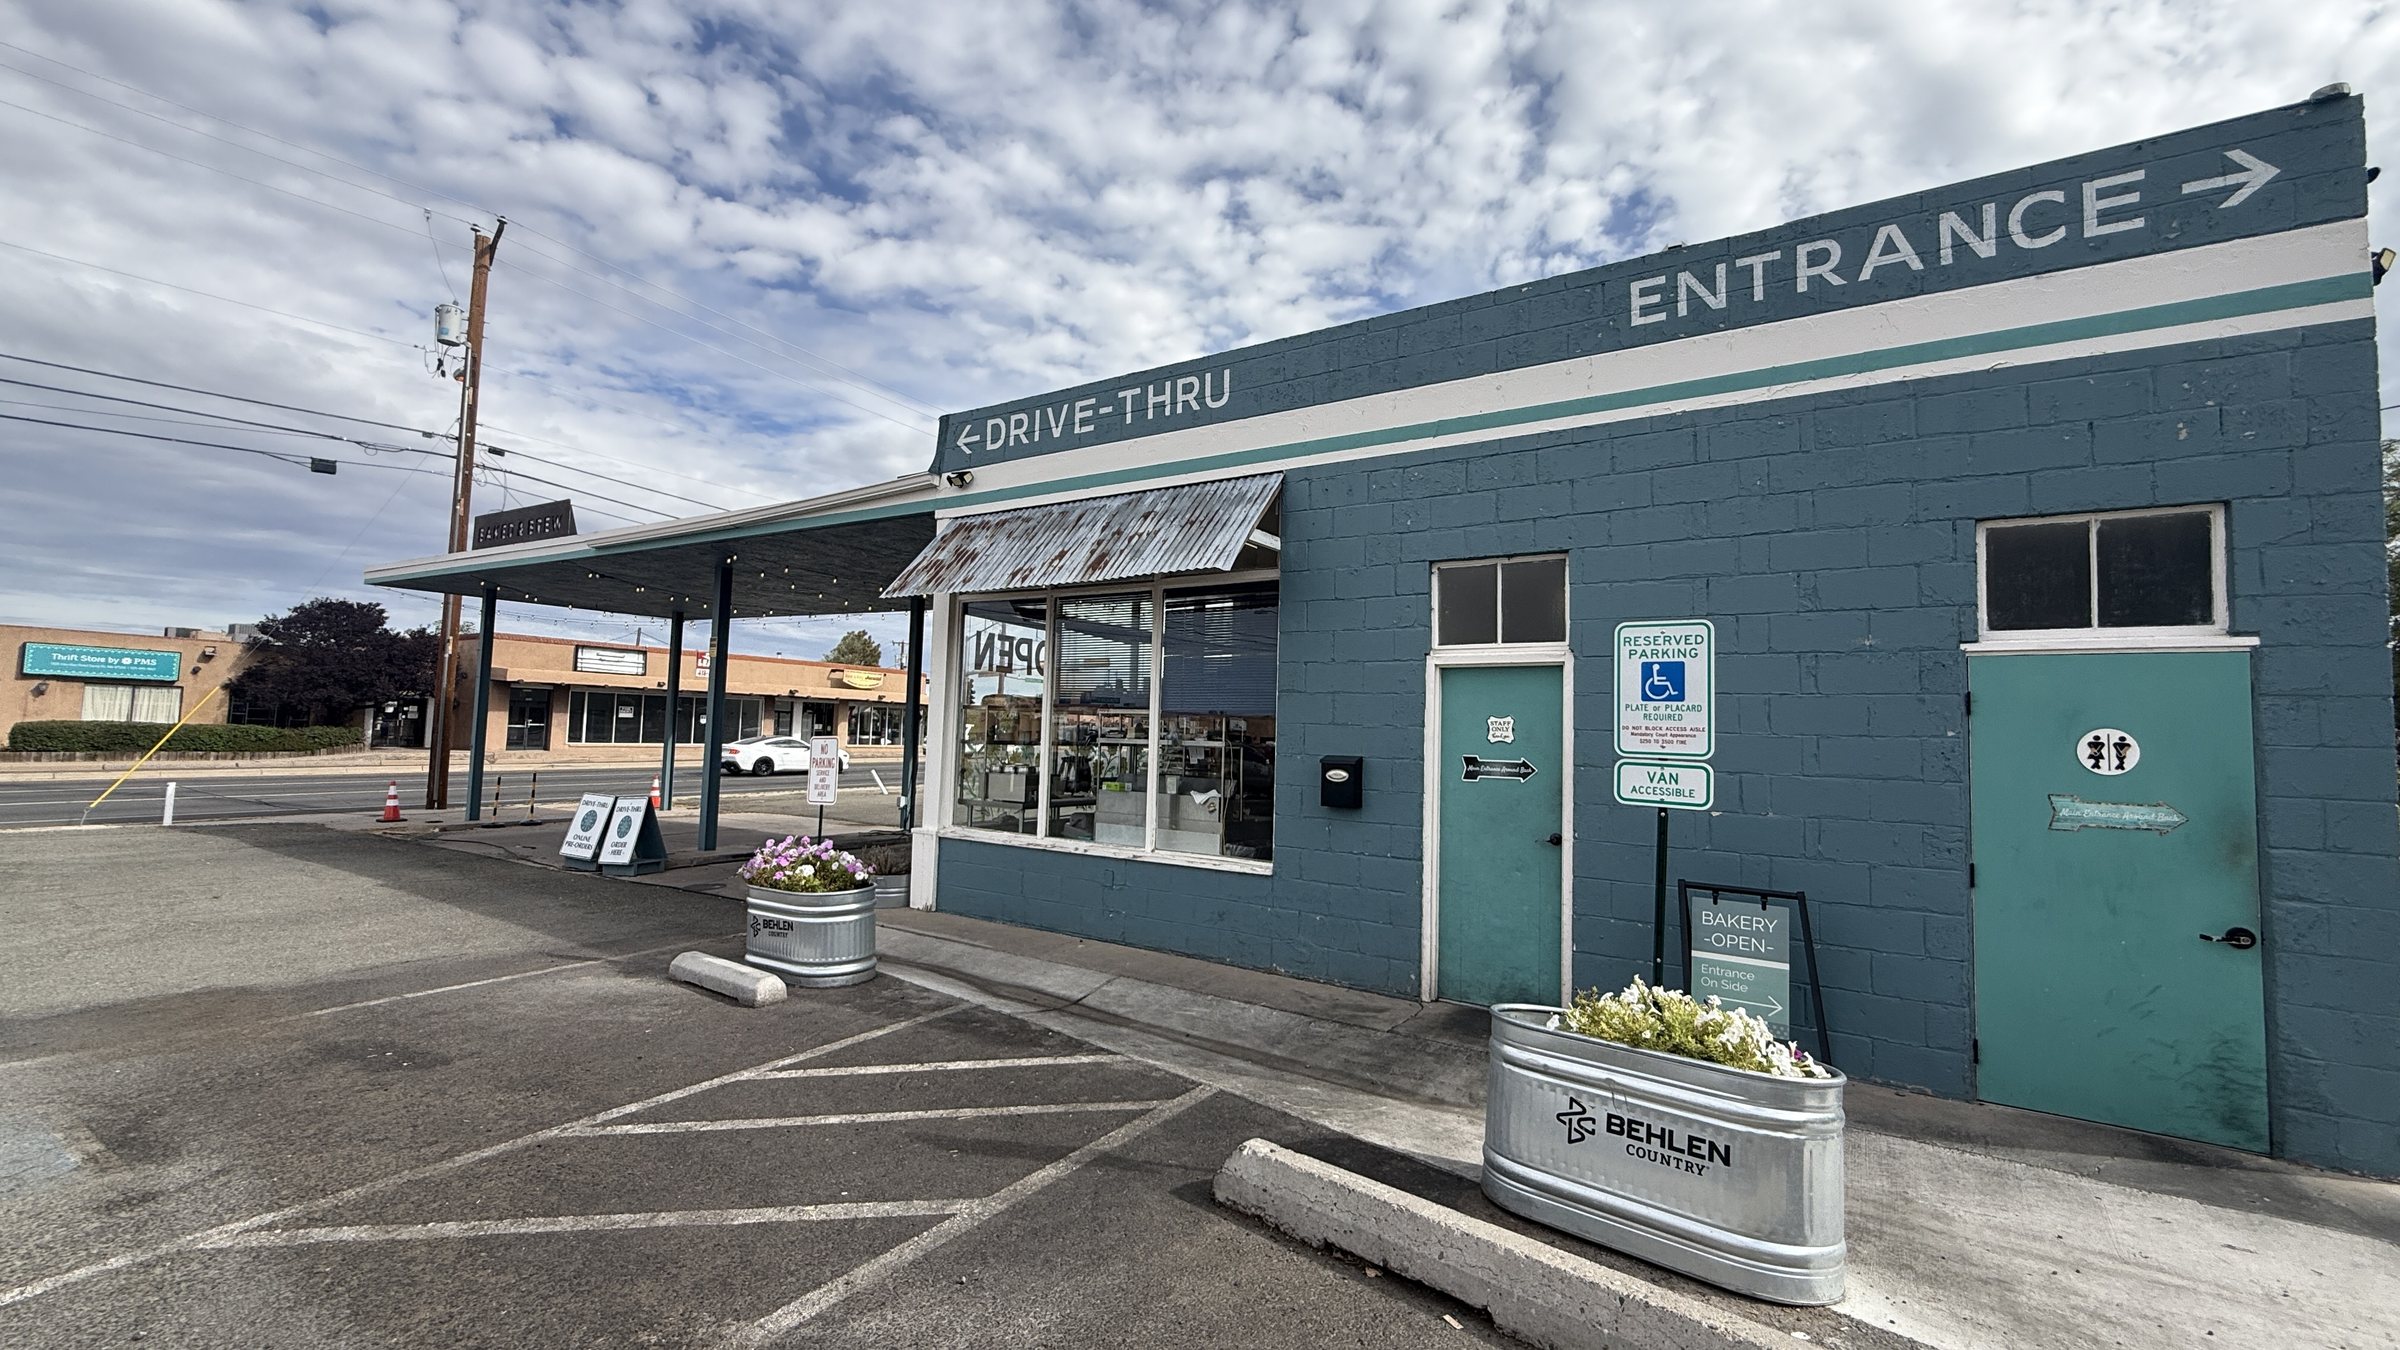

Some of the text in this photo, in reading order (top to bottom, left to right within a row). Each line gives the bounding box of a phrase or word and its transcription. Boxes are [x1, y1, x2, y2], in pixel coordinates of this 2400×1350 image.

[1629, 168, 2146, 327] ENTRANCE
[986, 368, 1231, 451] DRIVE-THRU
[1623, 634, 1705, 647] RESERVED
[1628, 647, 1699, 660] PARKING
[108, 656, 120, 665] by
[133, 657, 157, 666] PMS
[1625, 703, 1649, 711] PLATE
[1664, 704, 1703, 712] PLACARD
[1643, 713, 1683, 721] REQUIRED
[821, 744, 829, 754] NO
[812, 757, 835, 768] PARKING
[1647, 770, 1679, 785] VAN
[1630, 785, 1696, 799] ACCESSIBLE
[2060, 807, 2082, 817] Main
[2083, 808, 2120, 819] Entrance
[573, 834, 591, 842] ONLINE
[762, 918, 794, 932] BEHLEN
[1701, 910, 1778, 933] BAKERY
[1701, 963, 1755, 981] Entrance
[1701, 976, 1749, 993] On Side
[1606, 1112, 1732, 1168] BEHLEN
[1625, 1143, 1706, 1177] COUNTRY
